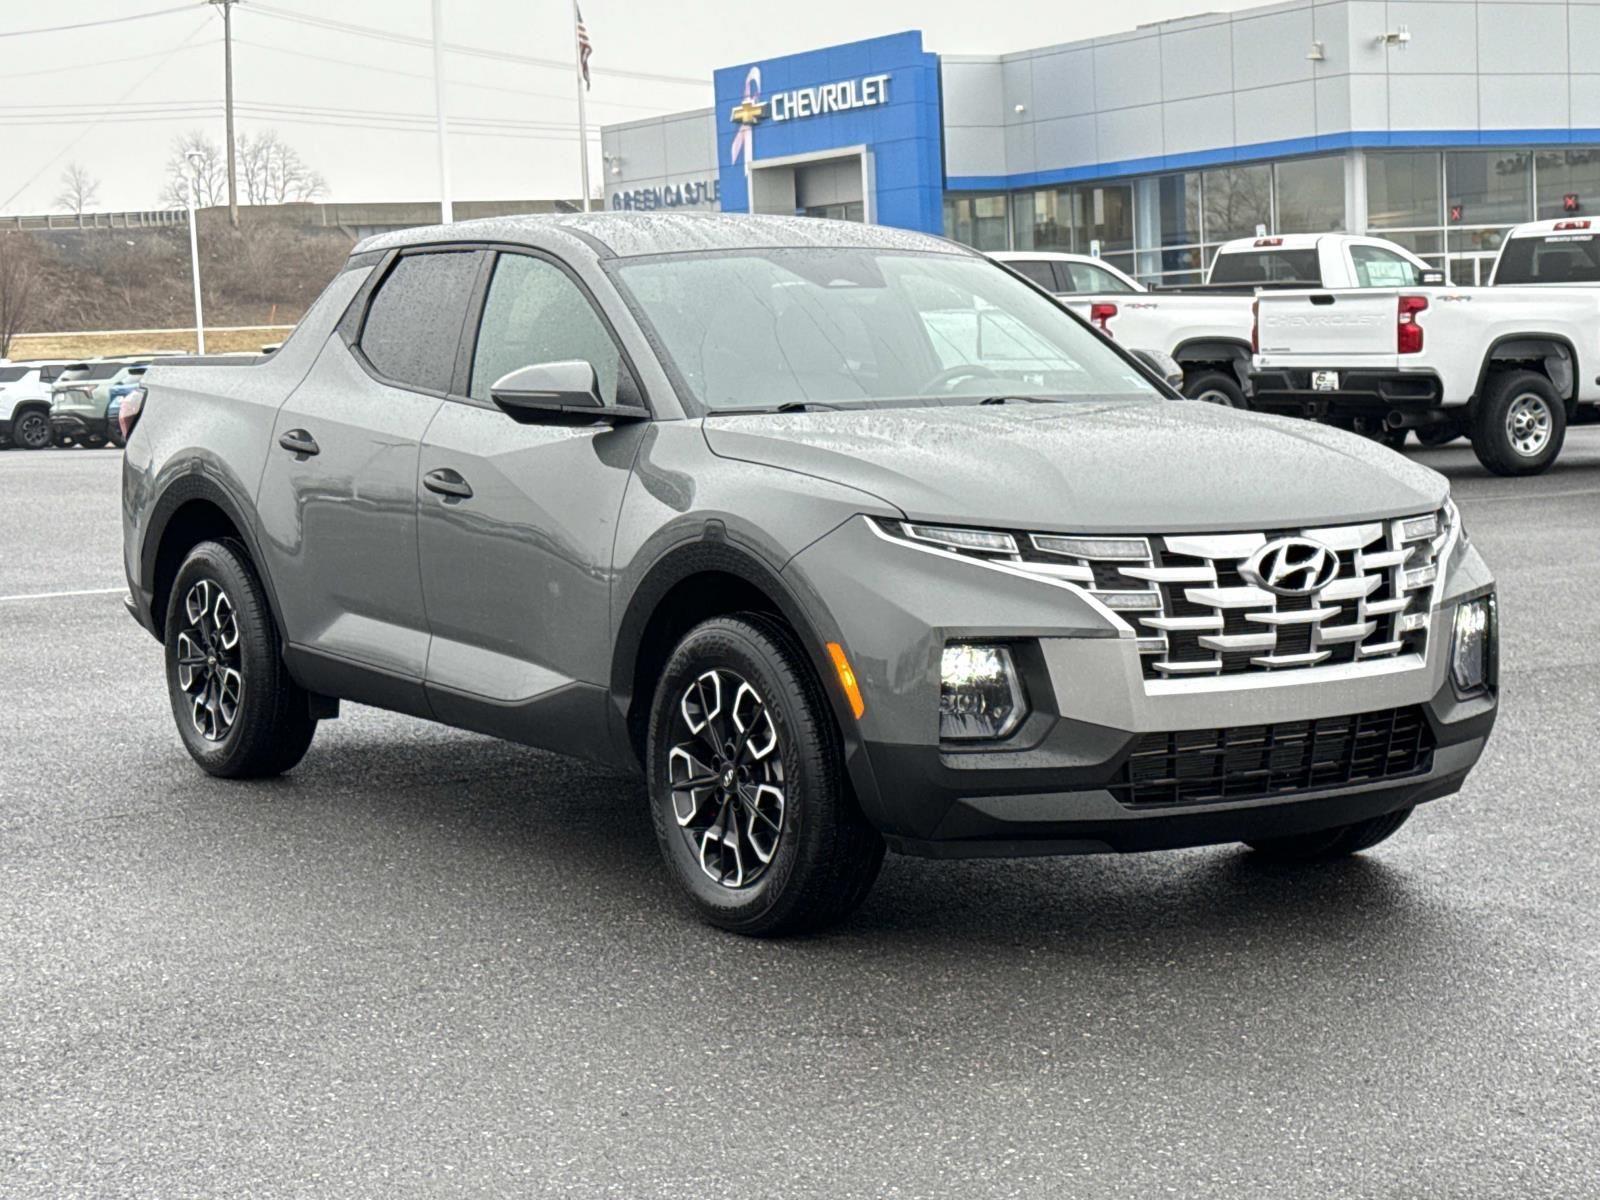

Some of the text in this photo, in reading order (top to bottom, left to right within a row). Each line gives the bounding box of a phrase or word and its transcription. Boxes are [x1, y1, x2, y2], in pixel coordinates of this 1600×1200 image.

[771, 74, 889, 121] CHEVROLET
[612, 180, 720, 212] GREENCASTLE
[1265, 312, 1387, 328] CHEVROLET
